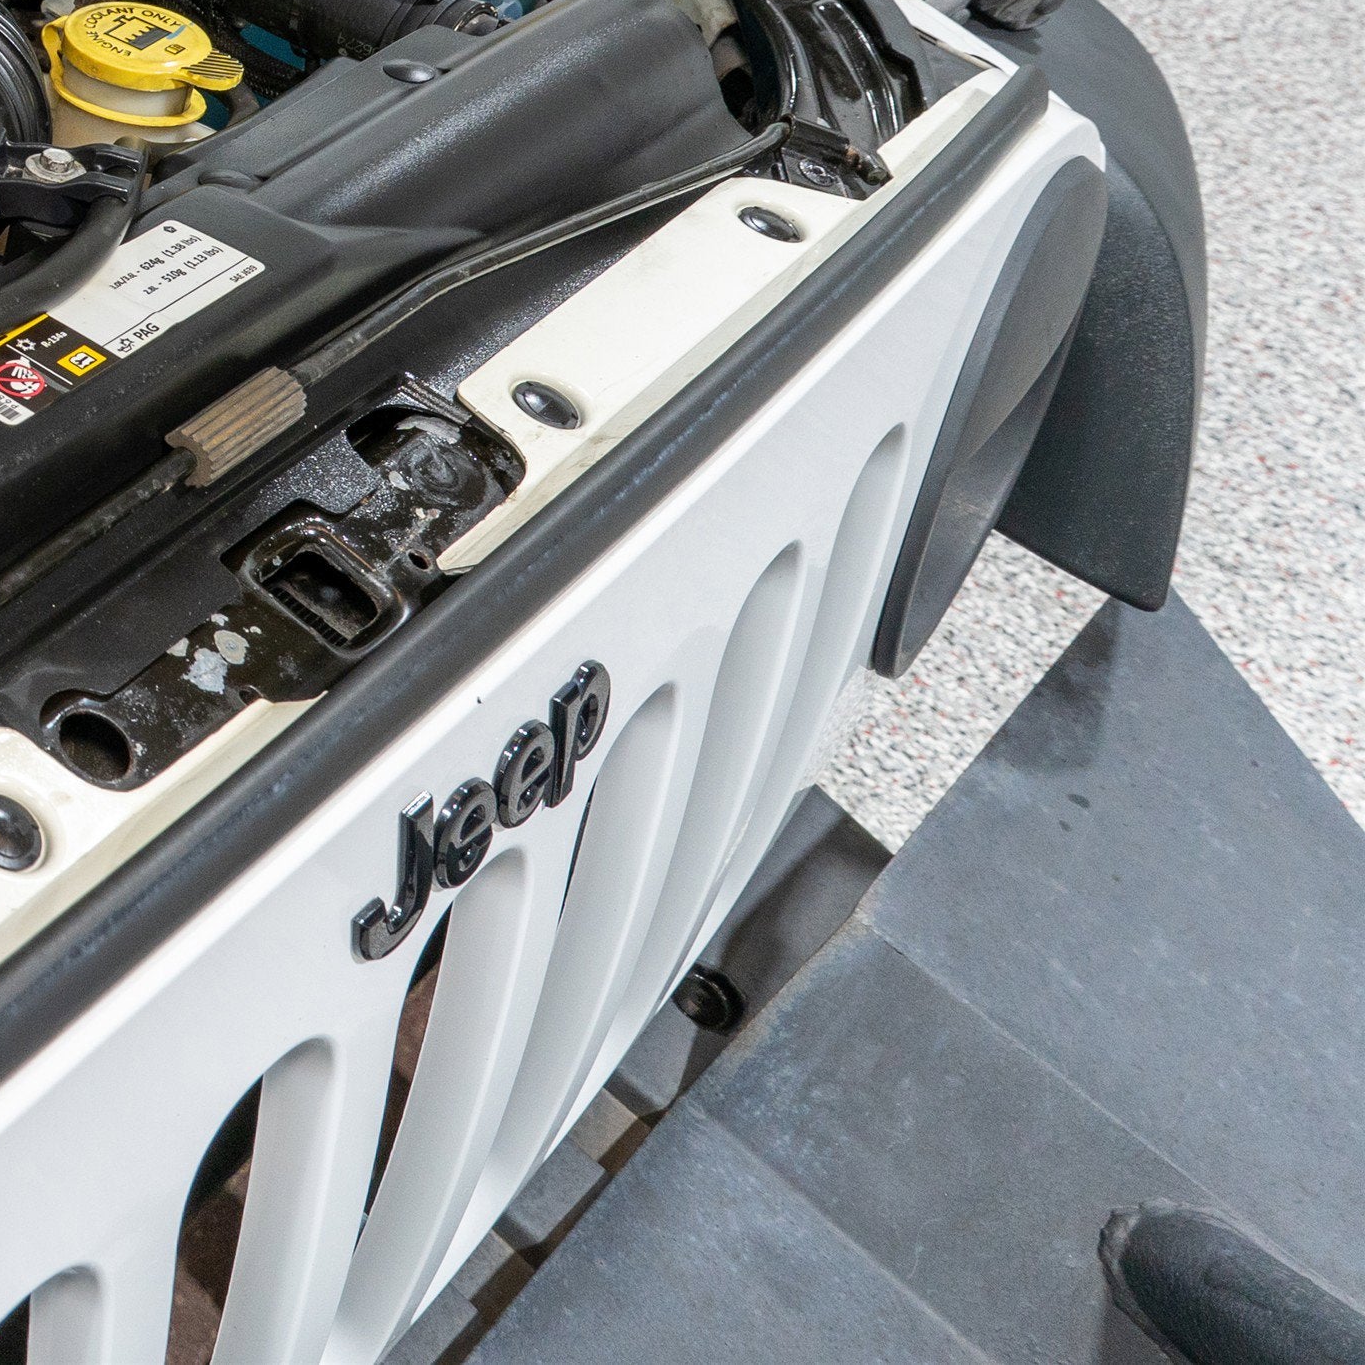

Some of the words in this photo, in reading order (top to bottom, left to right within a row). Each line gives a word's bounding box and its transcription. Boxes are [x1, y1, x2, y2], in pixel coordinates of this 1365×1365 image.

[85, 7, 136, 29] COOLANT
[141, 10, 181, 27] ONLY
[86, 30, 132, 57] ENGINE
[139, 257, 165, 271] 624g
[161, 244, 186, 258] (1.38
[182, 235, 202, 247] lbs)
[161, 268, 187, 283] 510g
[183, 254, 208, 270] (1.13
[203, 245, 224, 258] lbs)
[229, 273, 244, 284] SAE
[41, 331, 68, 348] R-134a
[133, 322, 160, 341] PAG
[351, 659, 611, 961] Jeep
